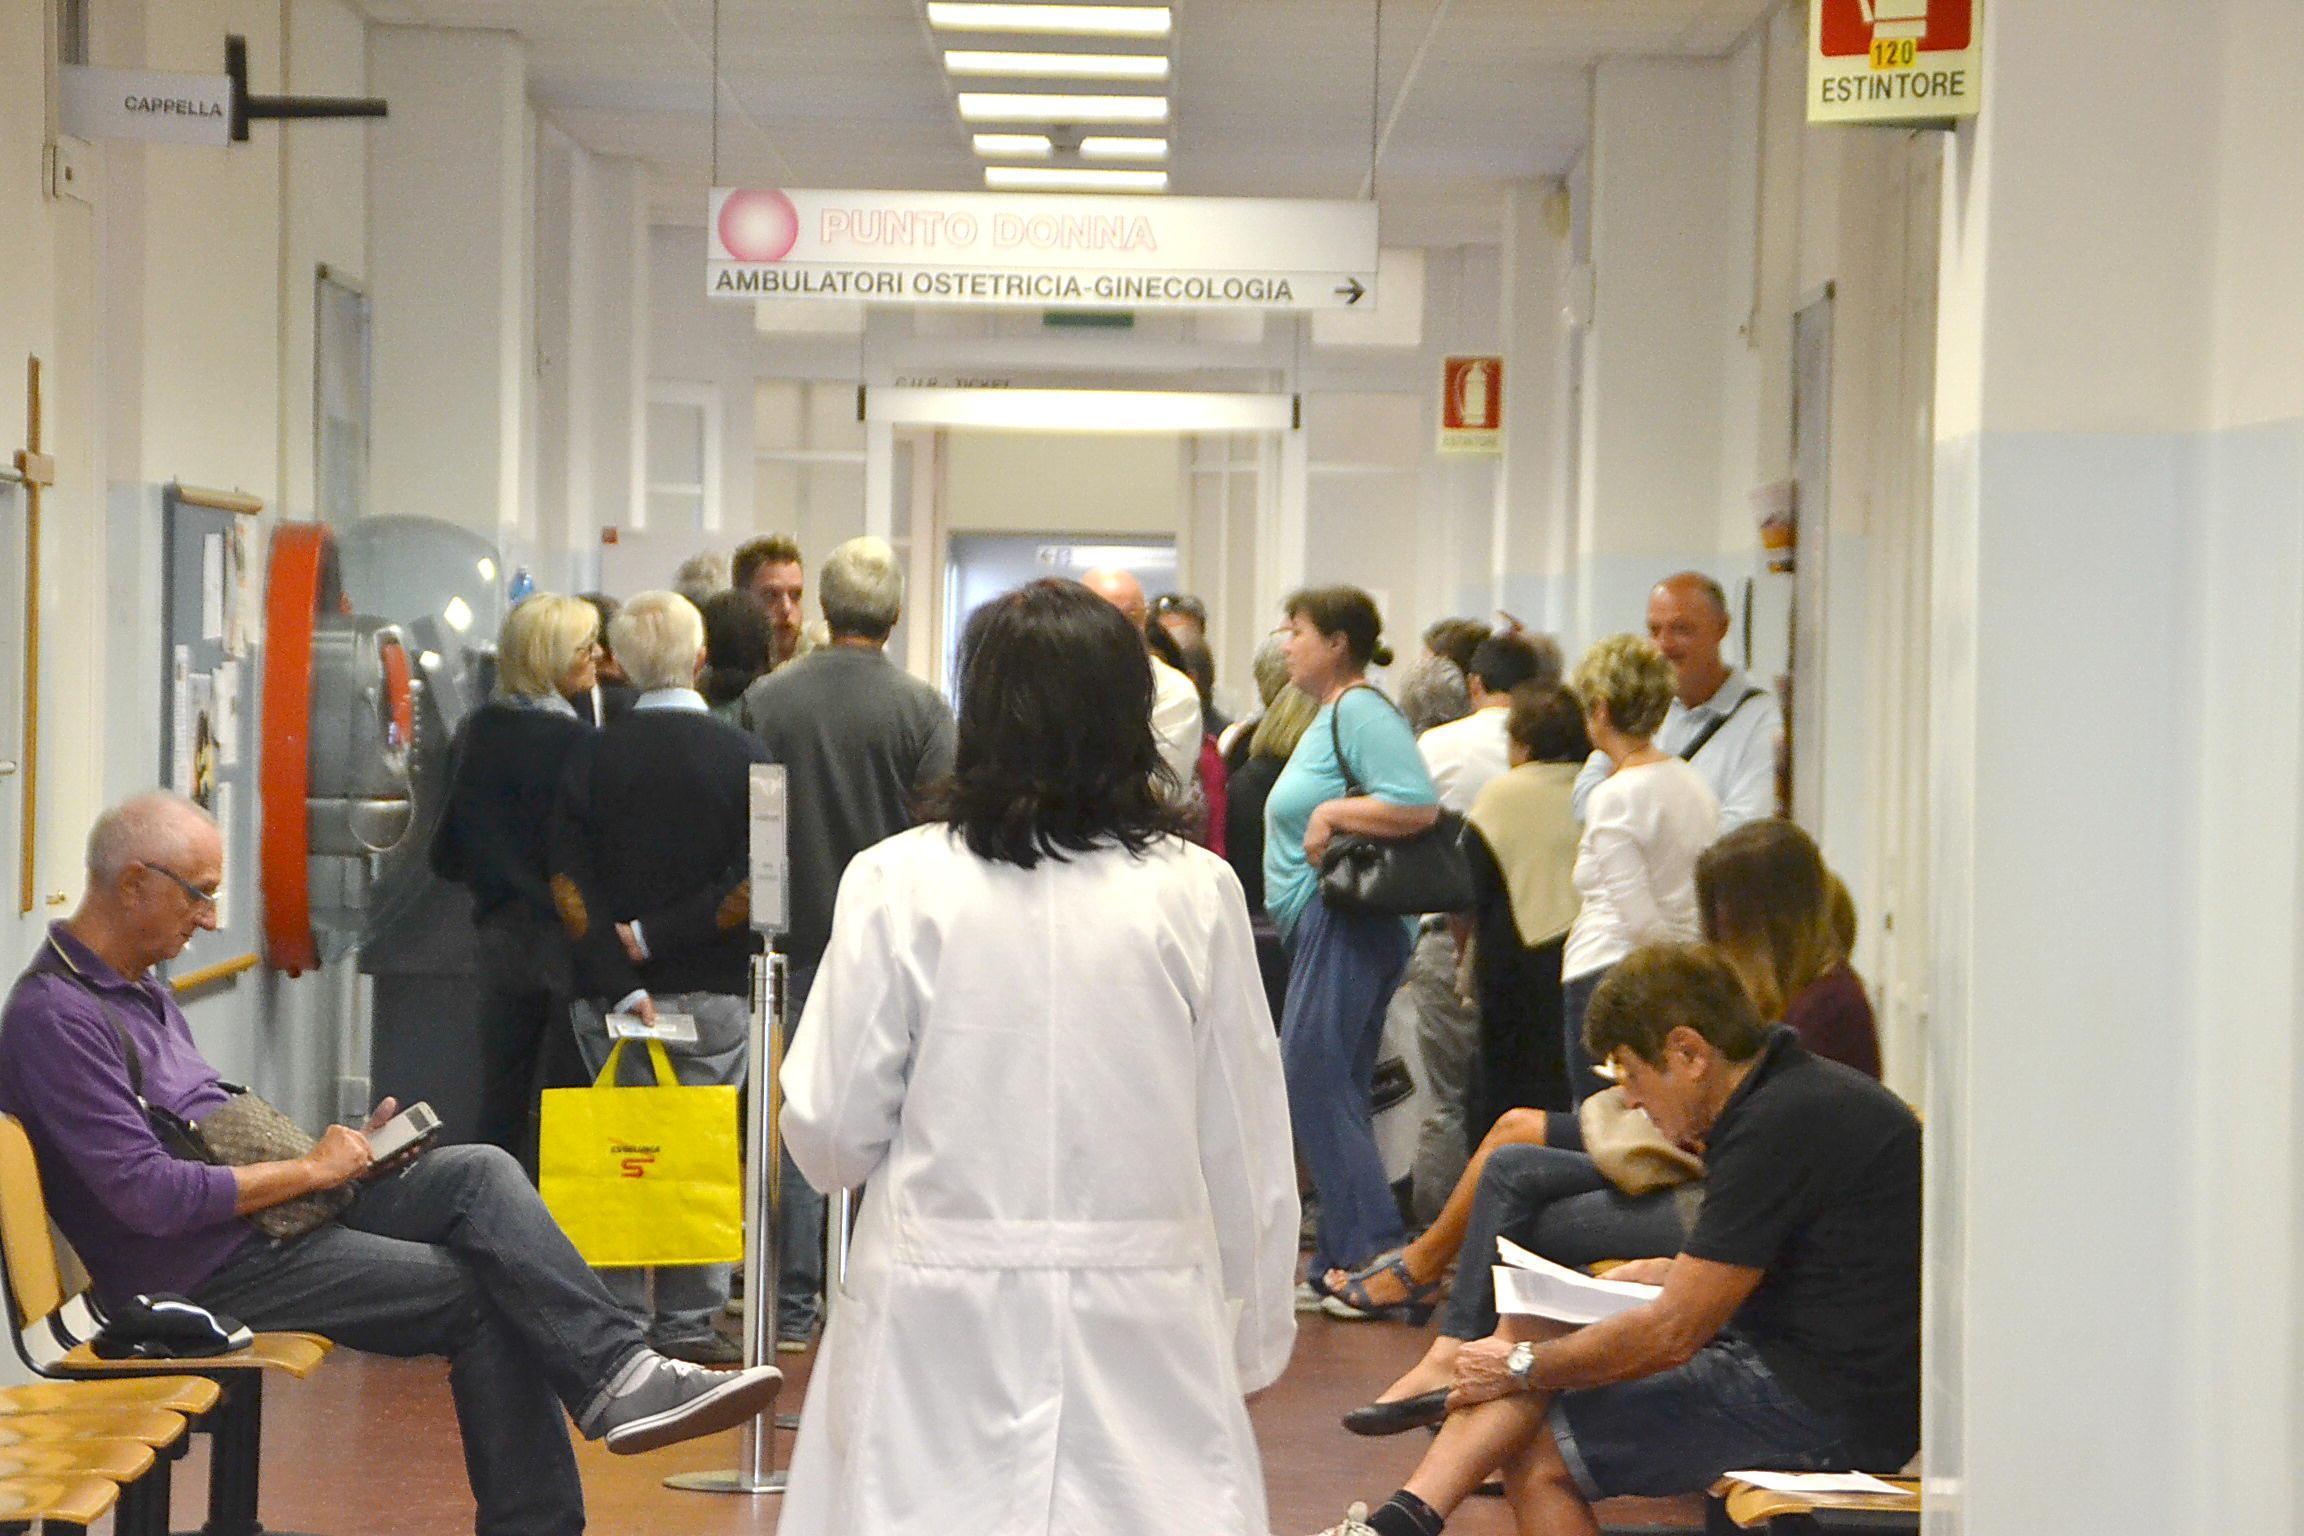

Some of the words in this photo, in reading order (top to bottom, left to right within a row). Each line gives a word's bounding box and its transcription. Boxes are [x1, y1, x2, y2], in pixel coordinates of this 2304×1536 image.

[1874, 40, 1914, 66] 120
[1821, 70, 1966, 103] ESTINTORE
[124, 96, 222, 117] CAPPELLA
[820, 207, 978, 247] PUNTO
[992, 213, 1158, 251] DONNA
[715, 269, 904, 294] AMBULATORI
[912, 272, 1294, 301] OSTETRICIA-GINECOLOGIA
